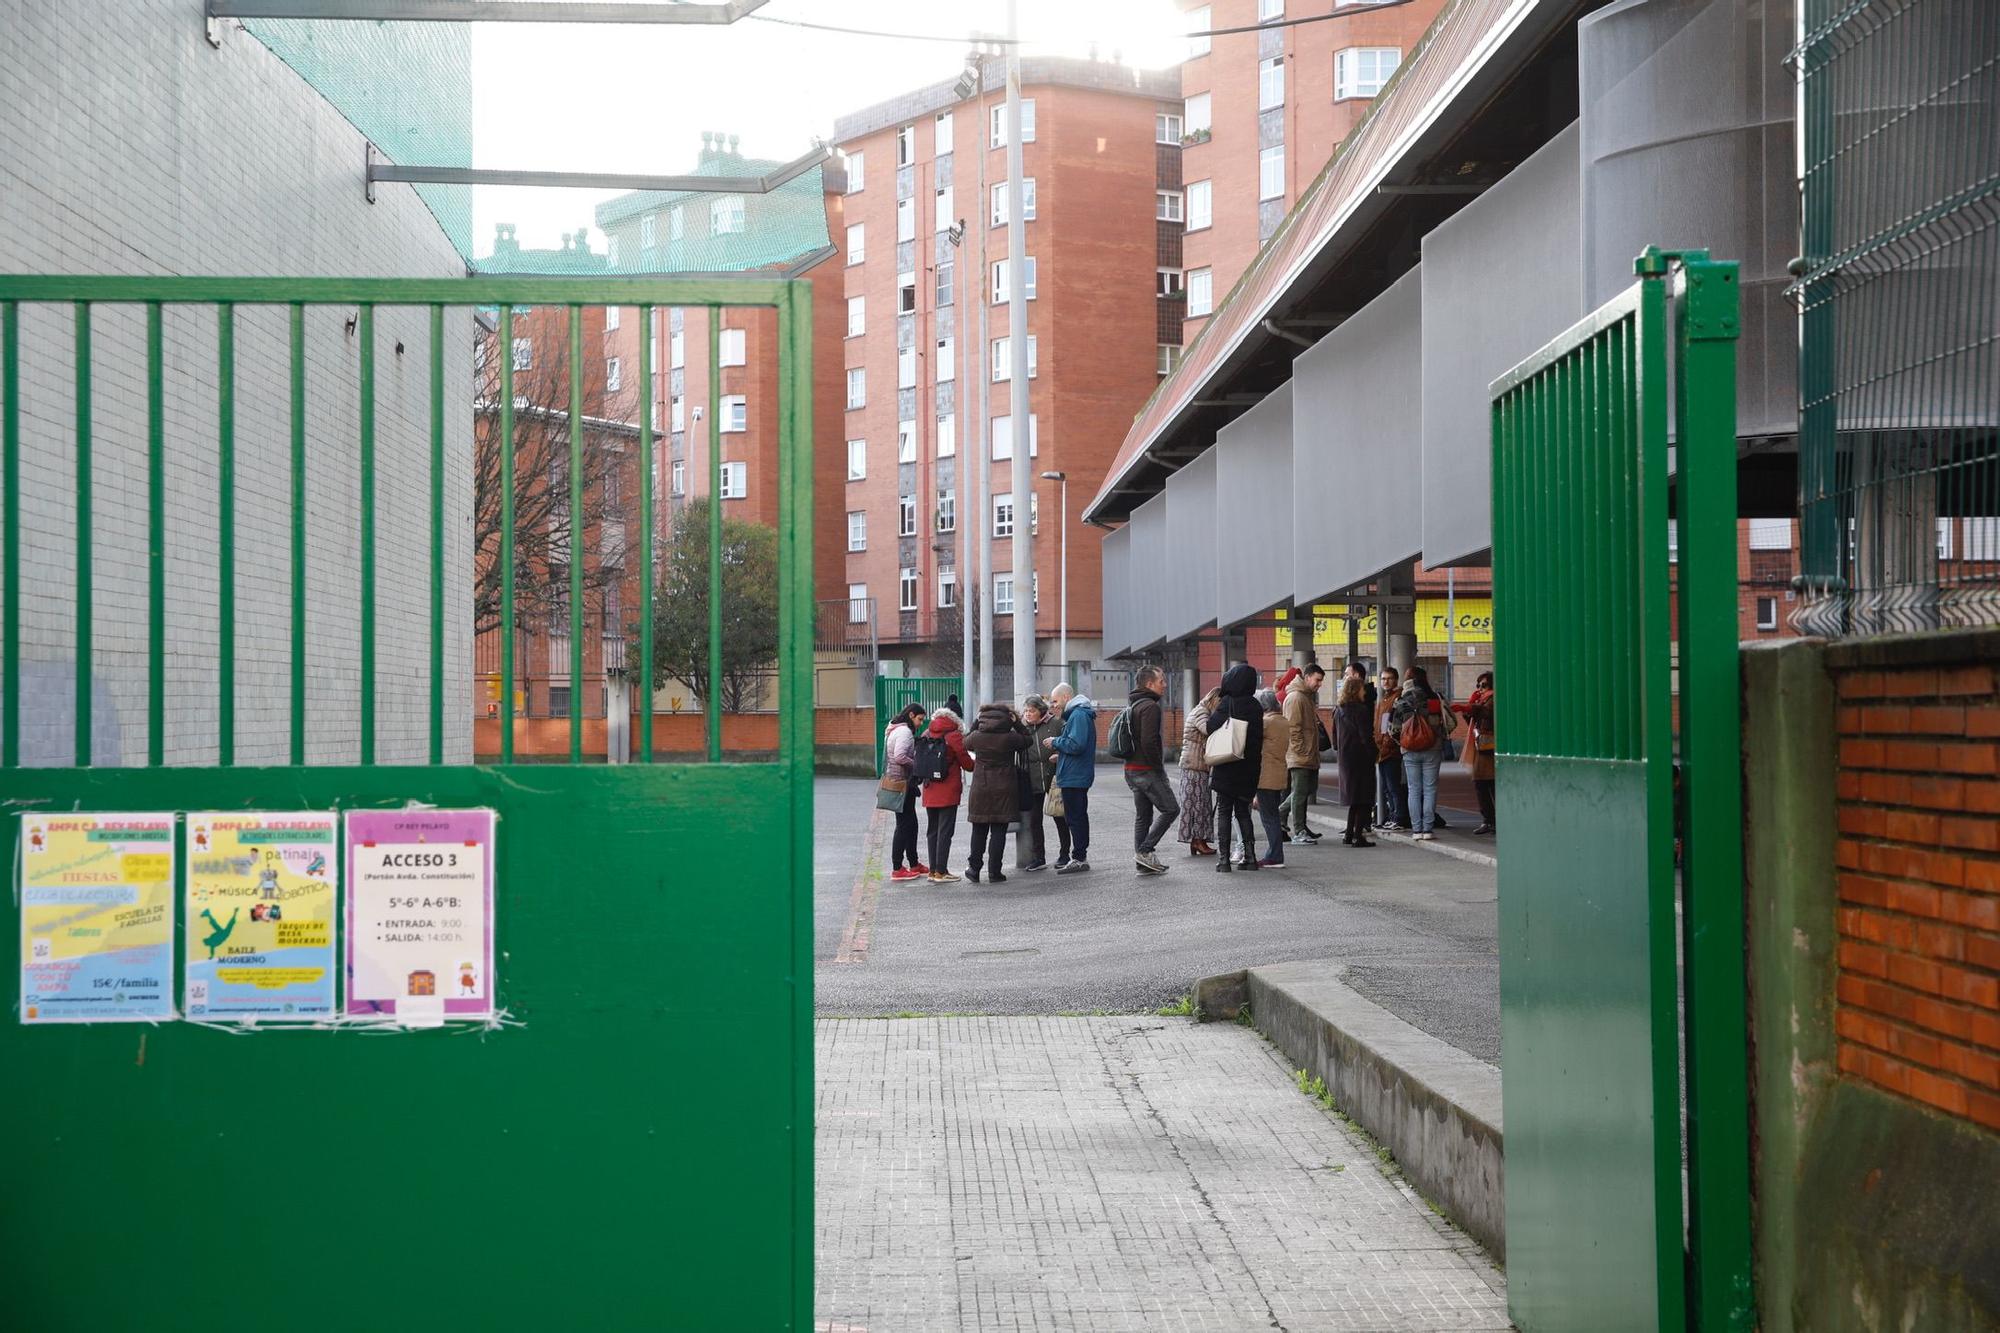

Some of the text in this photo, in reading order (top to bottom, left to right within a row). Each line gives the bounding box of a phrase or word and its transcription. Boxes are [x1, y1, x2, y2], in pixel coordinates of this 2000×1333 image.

[1460, 615, 1494, 628] Cos
[47, 822, 79, 832] AMPA
[212, 822, 242, 831] AMPA
[266, 849, 321, 861] patinaje
[382, 854, 457, 867] ACCESO 3
[62, 872, 119, 882] FIESTAS
[219, 886, 258, 896] MÚSICA
[114, 908, 152, 921] ESCUELA
[153, 905, 165, 914] DE
[120, 915, 162, 928] FAMILIAS
[385, 920, 436, 928] ENTRADA:
[385, 934, 424, 942] SALIDA:
[218, 956, 266, 964] MODERNO
